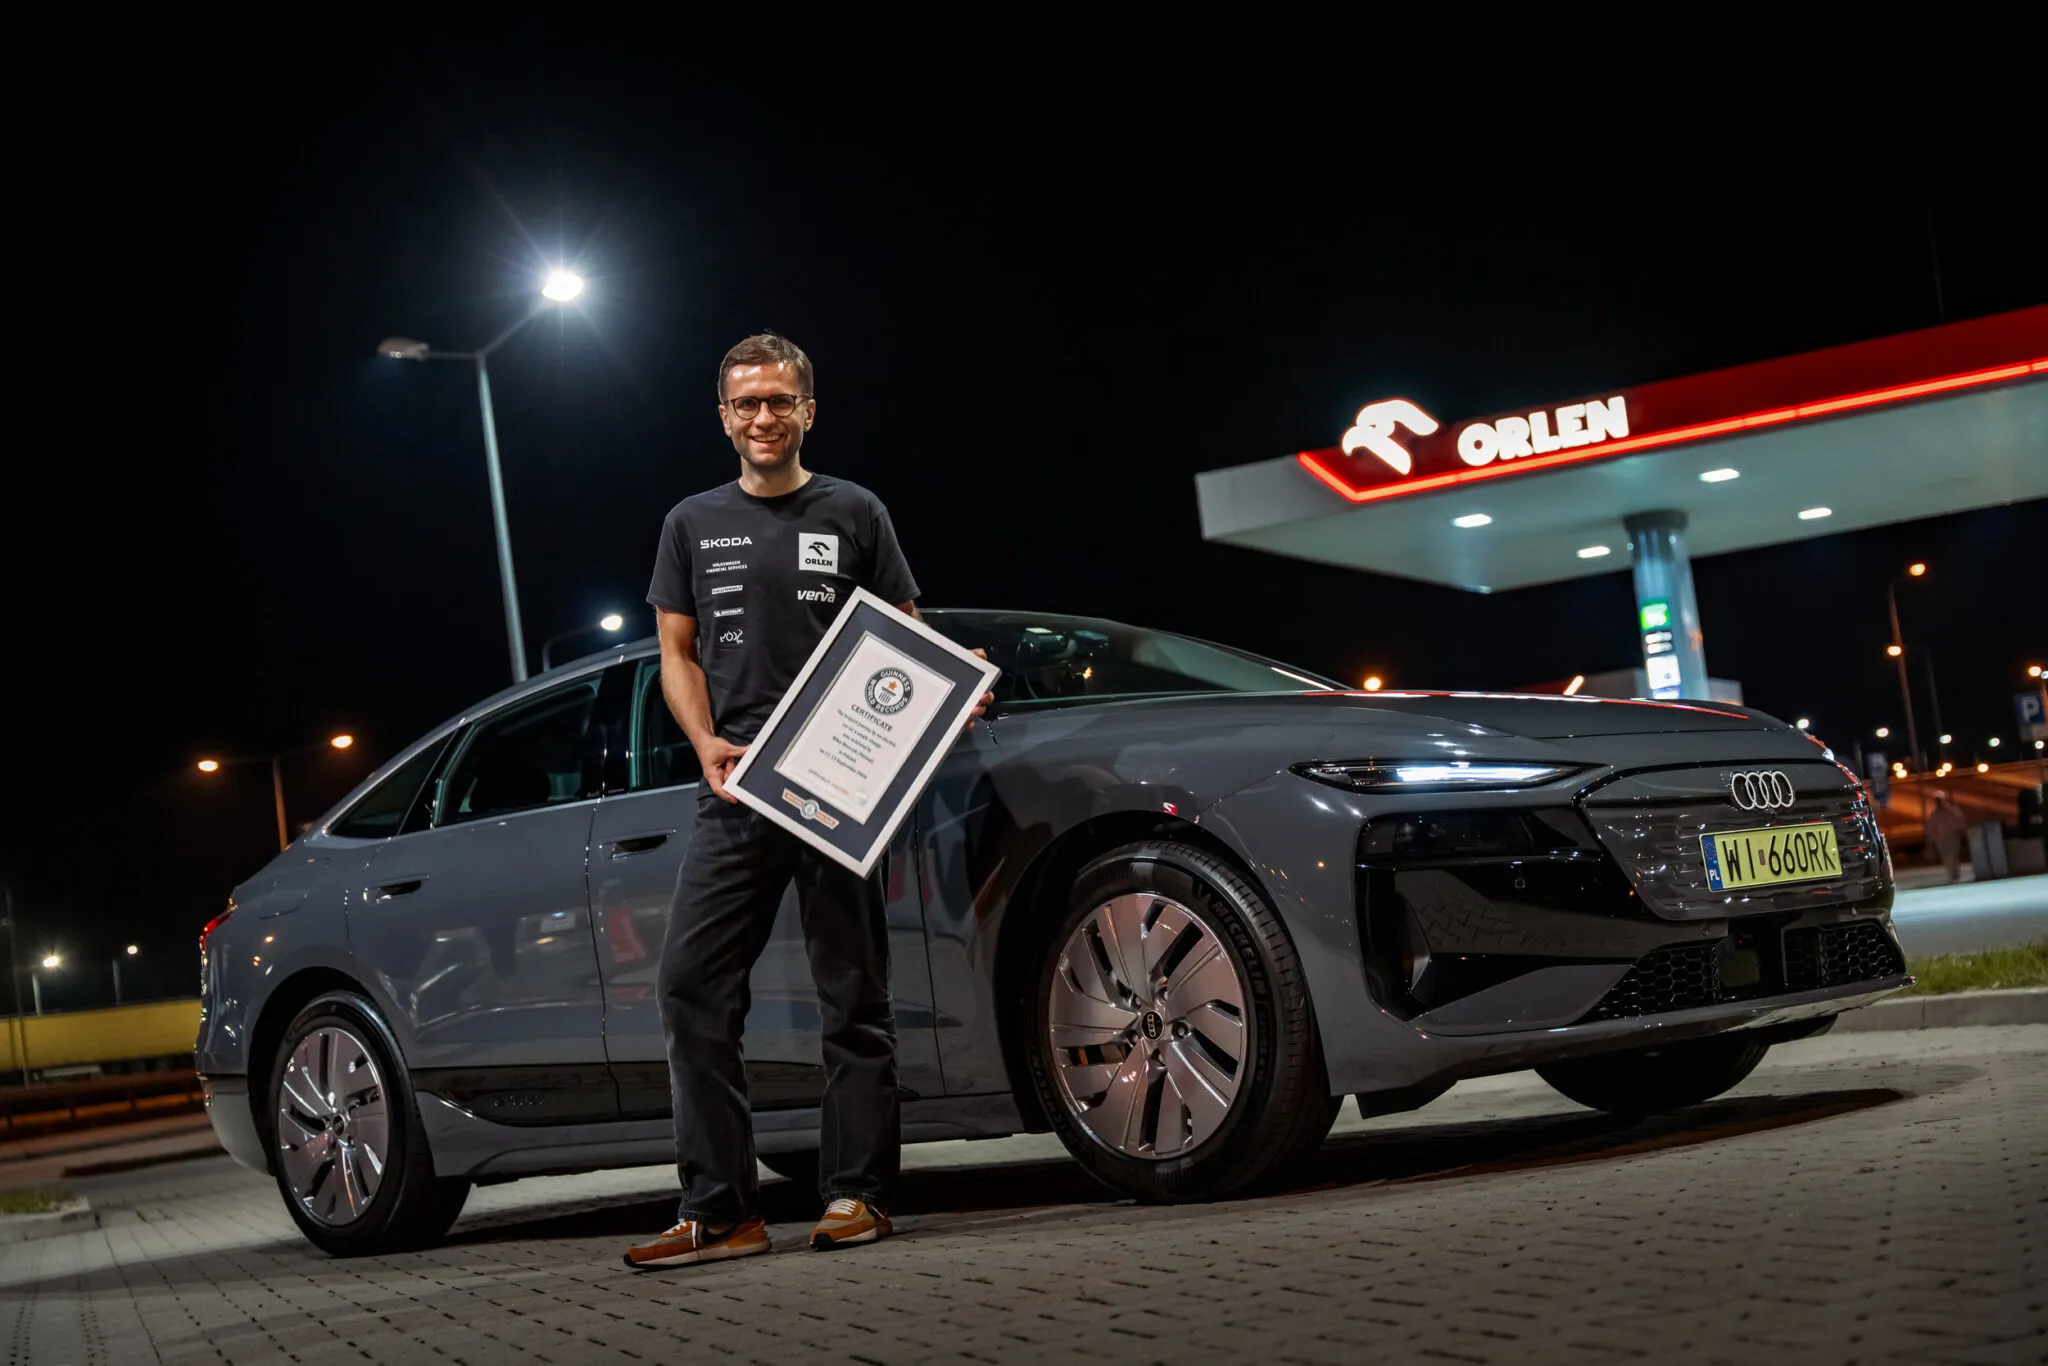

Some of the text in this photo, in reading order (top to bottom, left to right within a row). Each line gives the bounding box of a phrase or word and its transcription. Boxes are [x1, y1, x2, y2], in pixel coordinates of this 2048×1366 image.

[1457, 395, 1630, 466] ORLEN
[805, 558, 833, 567] ORLEN
[797, 584, 836, 603] verva
[880, 670, 910, 692] GUINNESS
[867, 678, 908, 712] WORLD RECORDS
[851, 704, 893, 732] CERTIFICATE
[2022, 696, 2040, 722] P
[1722, 830, 1836, 882] WI 660RK
[1709, 869, 1720, 881] PL
[1210, 901, 1267, 999] MICHELIN
